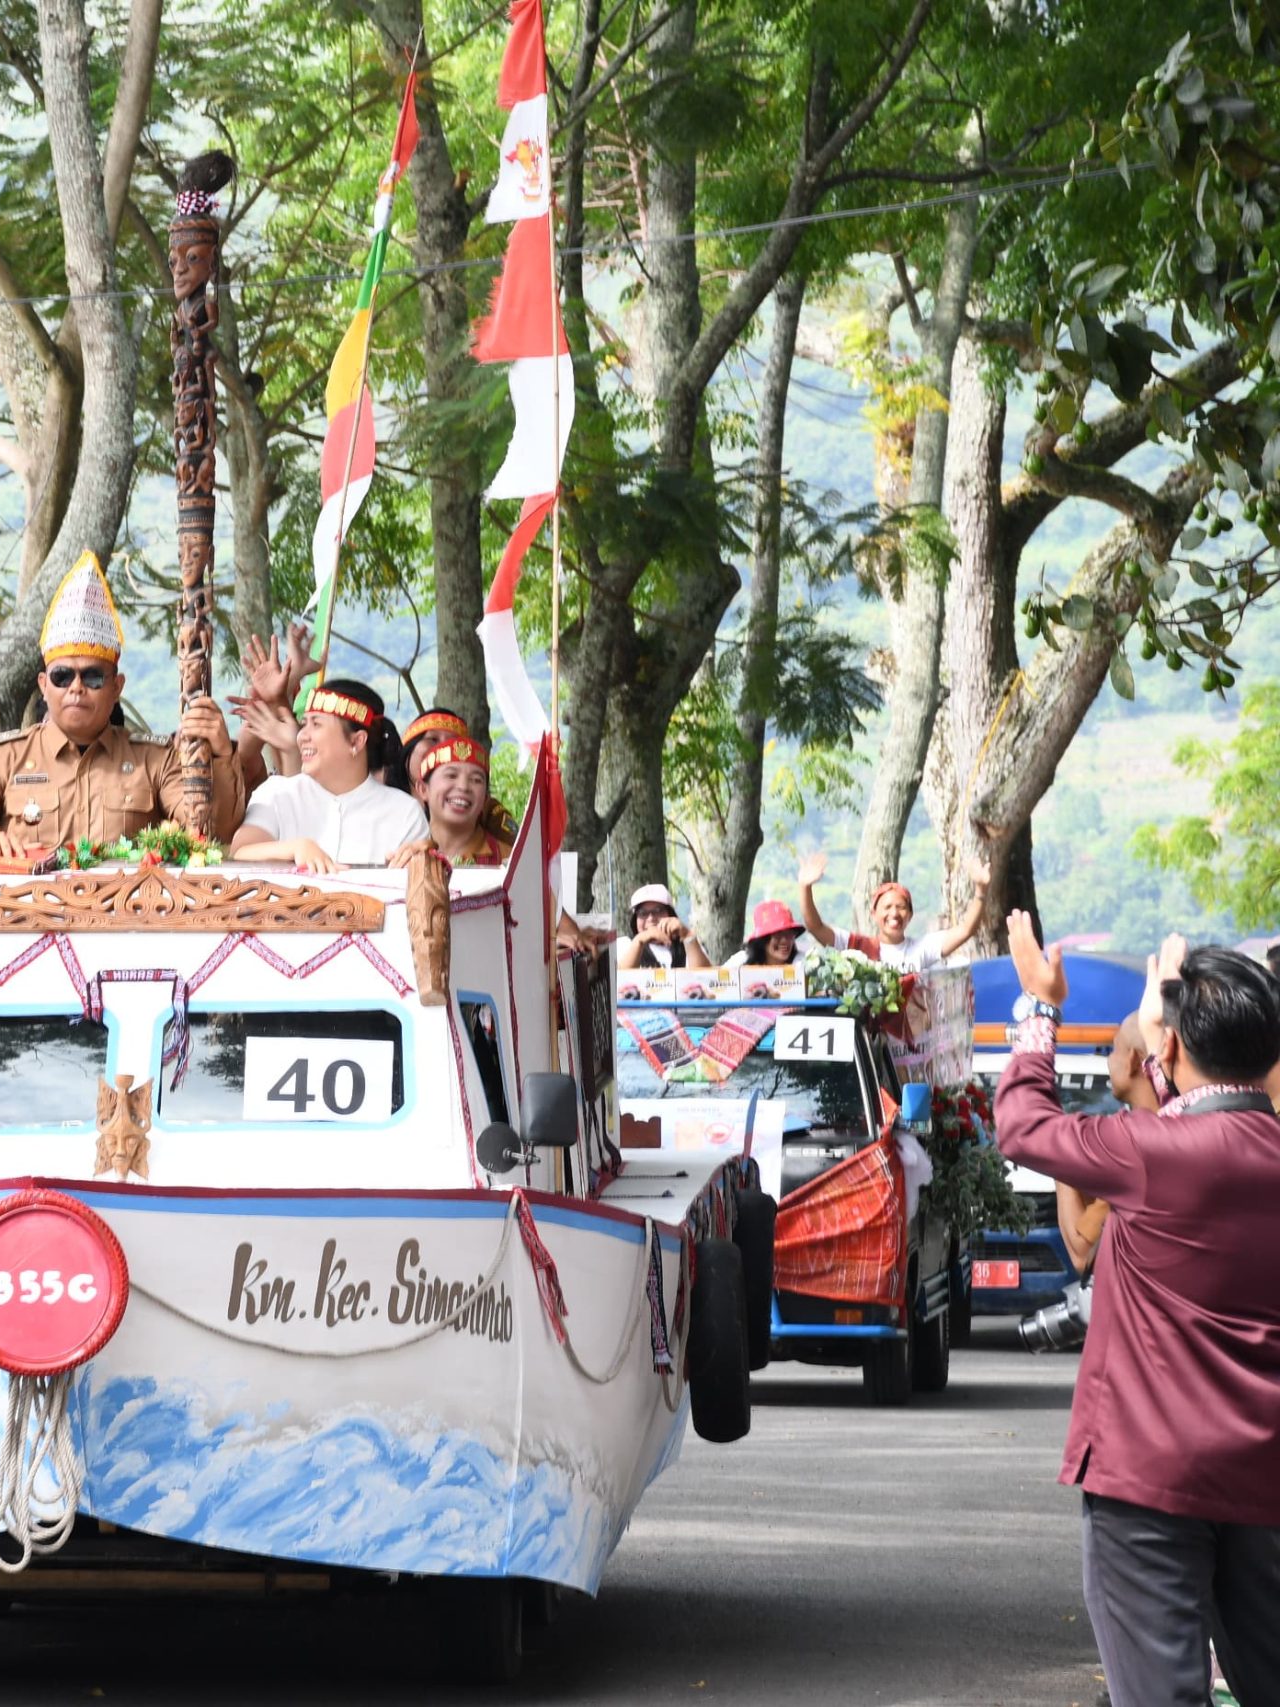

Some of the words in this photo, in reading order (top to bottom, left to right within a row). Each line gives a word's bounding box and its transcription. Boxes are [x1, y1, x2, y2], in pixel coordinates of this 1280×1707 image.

[787, 1027, 836, 1056] 41
[267, 1058, 366, 1116] 40
[387, 1237, 513, 1343] Simanindo
